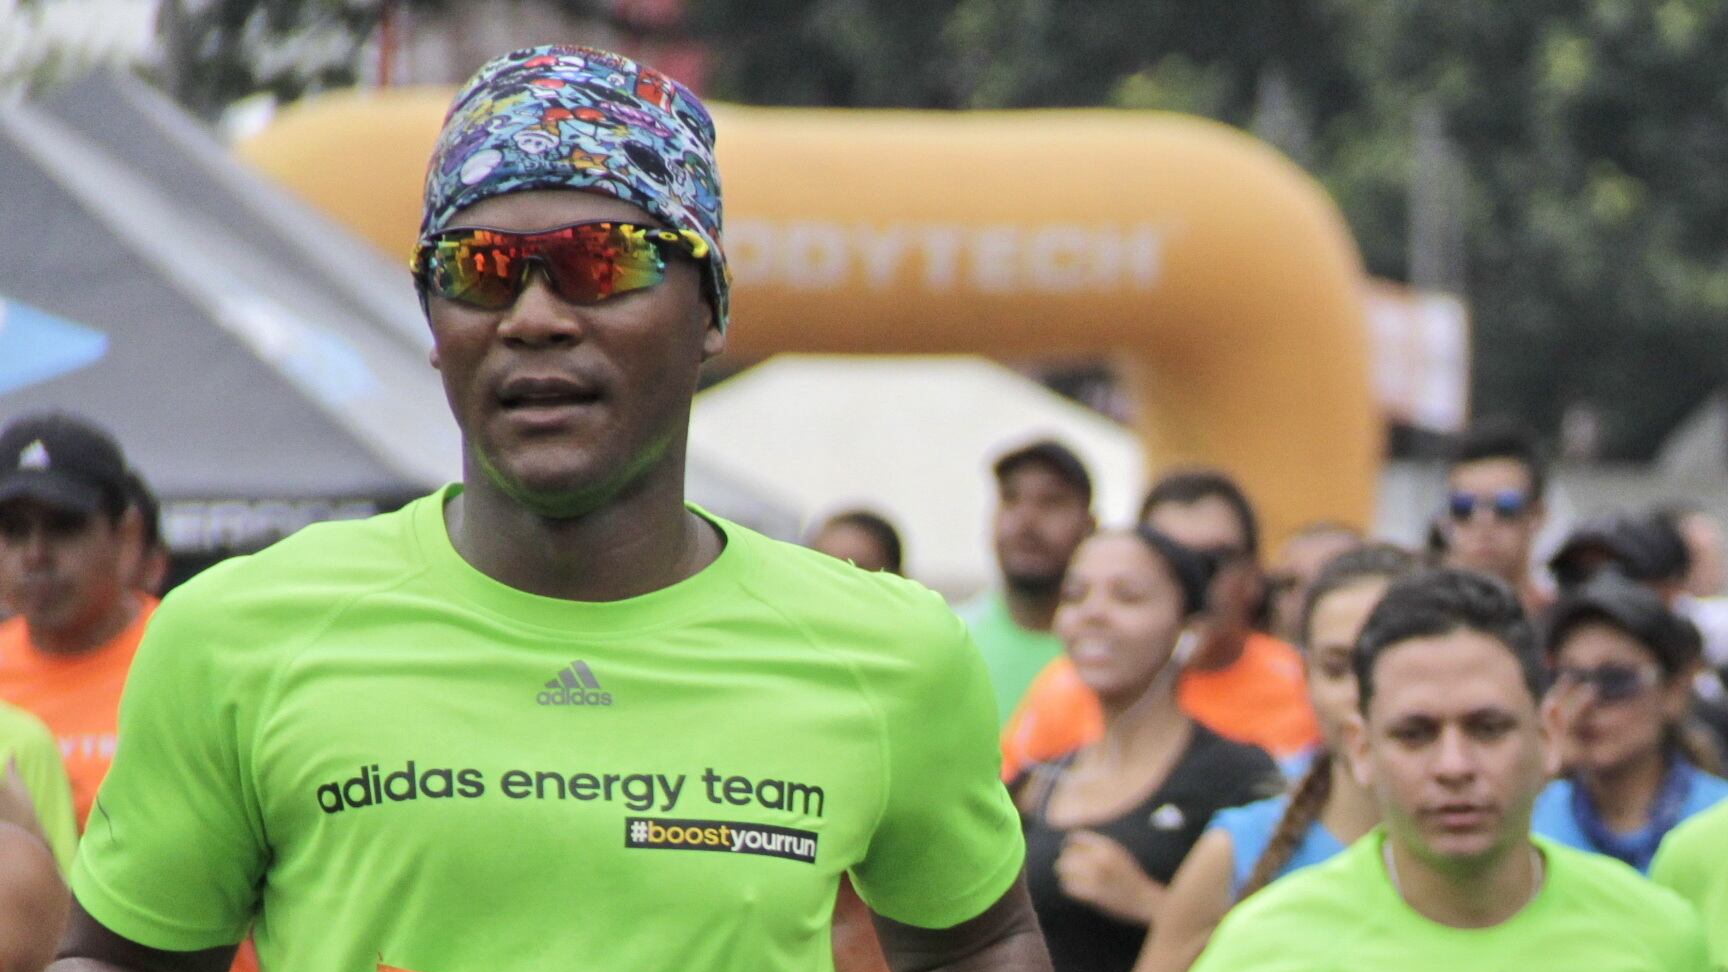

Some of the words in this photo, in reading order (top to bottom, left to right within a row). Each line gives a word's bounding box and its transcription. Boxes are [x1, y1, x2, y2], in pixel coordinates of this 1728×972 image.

[536, 682, 614, 706] adidas
[316, 760, 485, 815] adidas
[500, 767, 686, 812] energy
[701, 767, 825, 818] team
[630, 819, 816, 858] #boostyourrun
